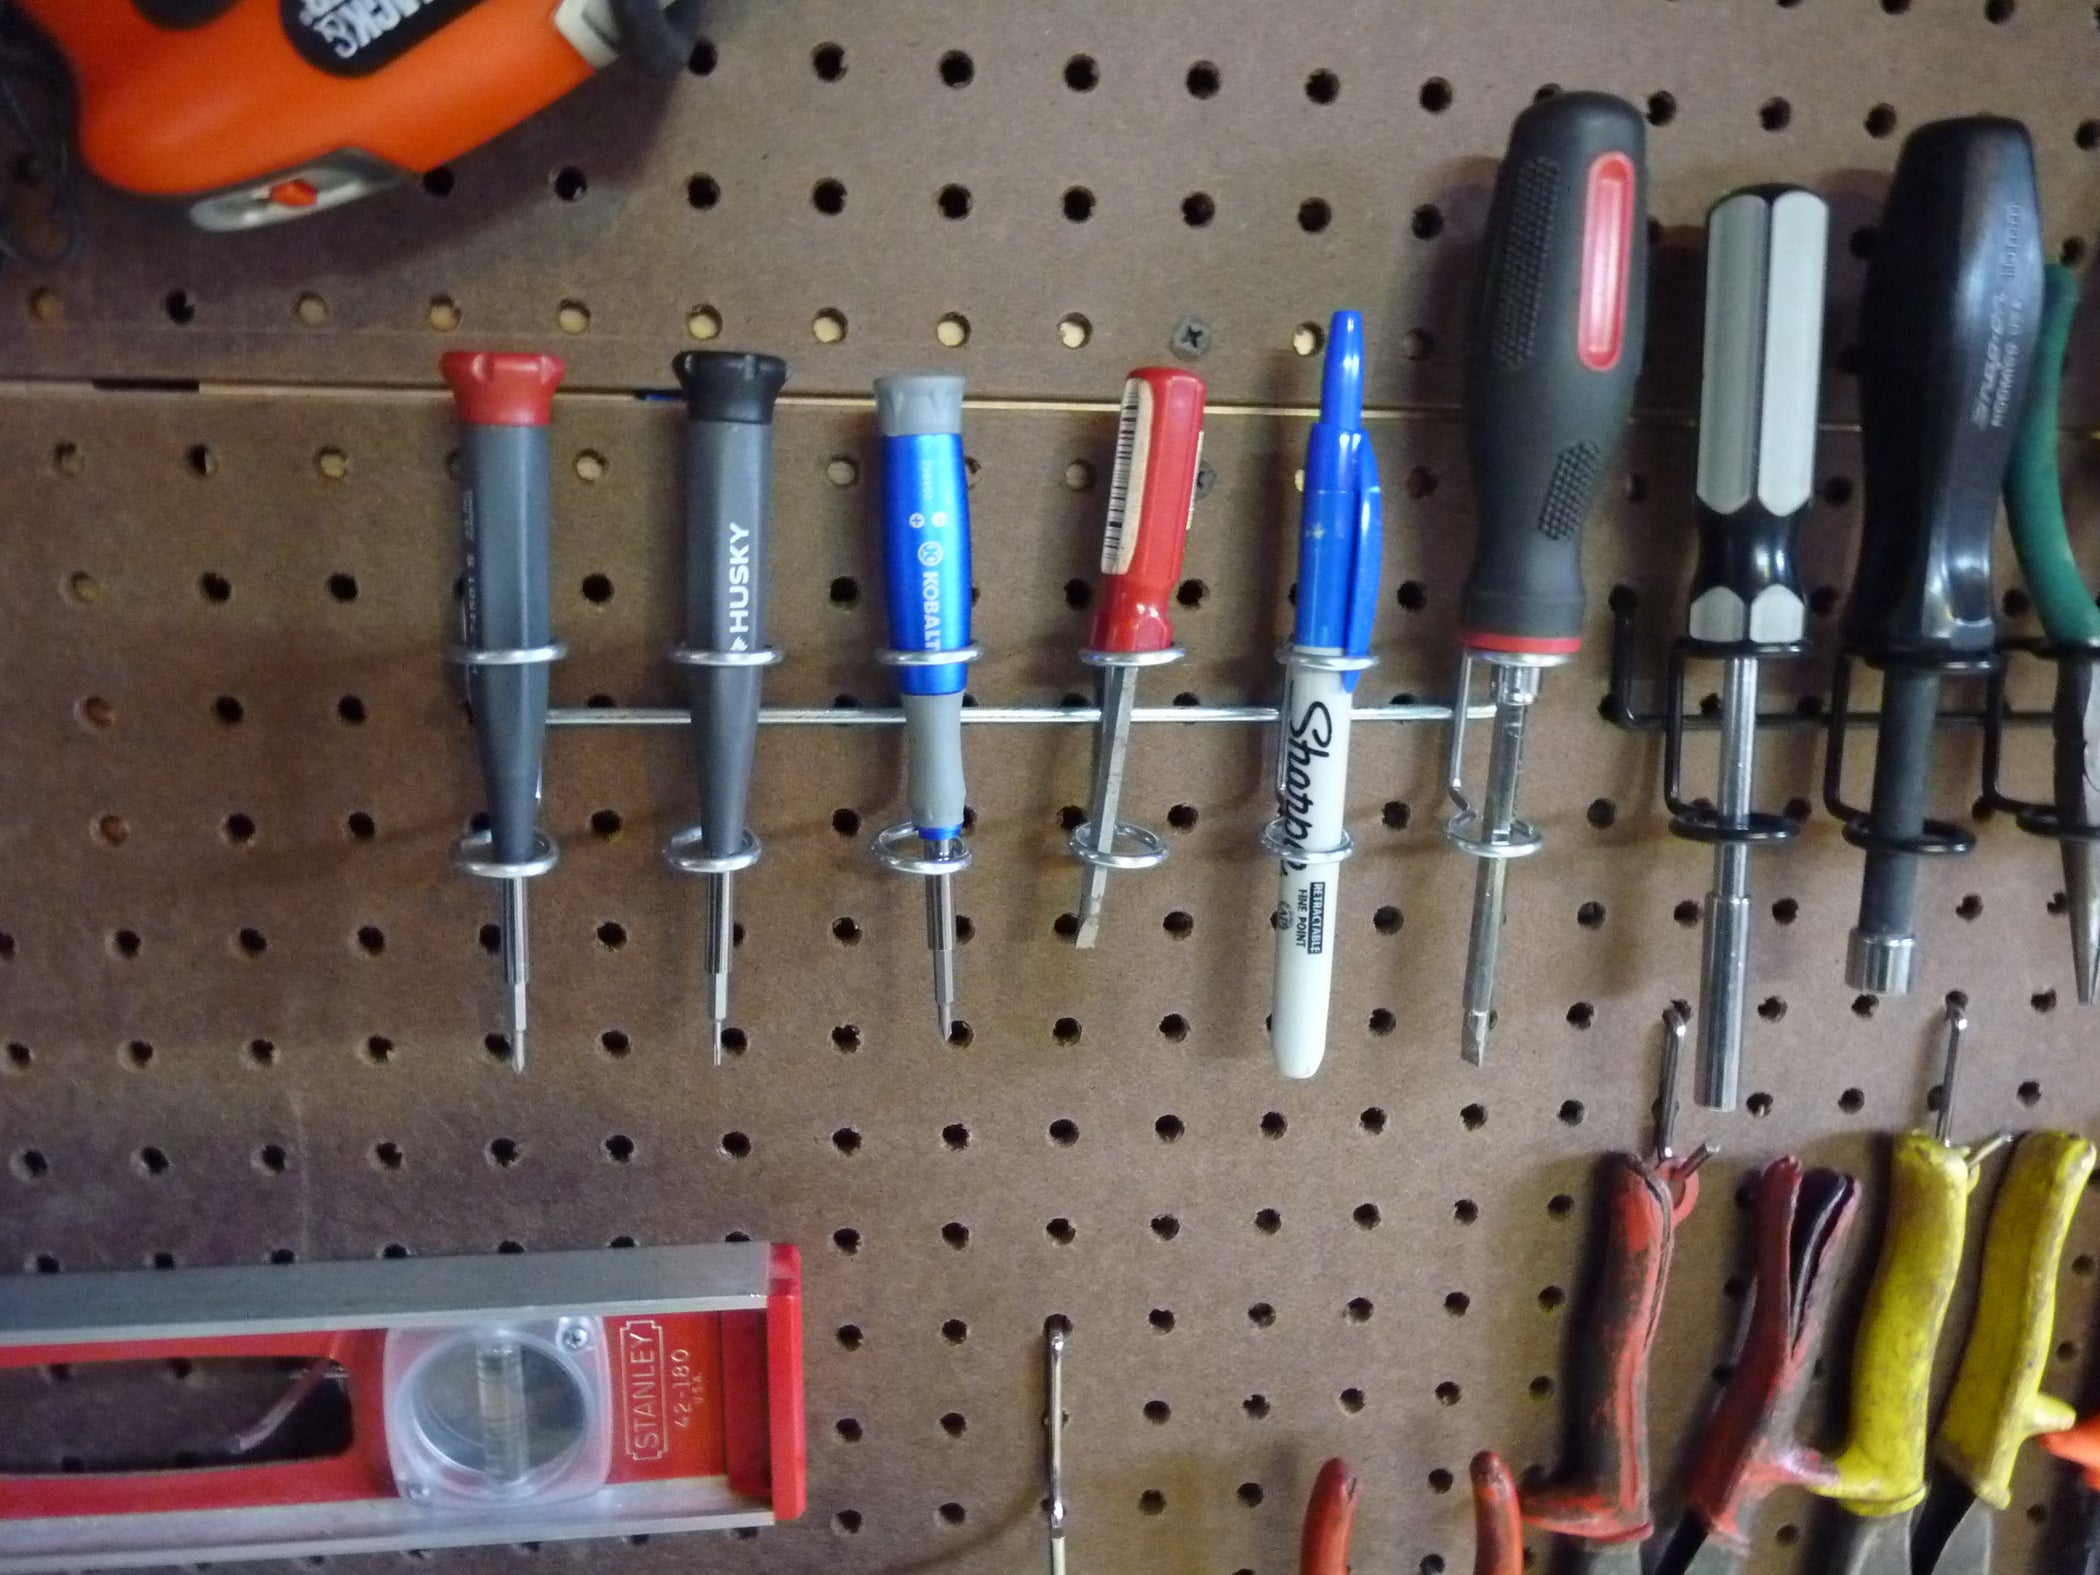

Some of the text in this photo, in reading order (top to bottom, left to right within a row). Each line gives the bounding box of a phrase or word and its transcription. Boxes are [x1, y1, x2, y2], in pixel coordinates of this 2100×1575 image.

[729, 521, 750, 633] HUSKY
[922, 570, 942, 652] KOBALT
[1296, 914, 1308, 949] POINT
[1309, 882, 1325, 954] RETRACTABLE
[630, 1332, 659, 1449] STANLEY
[670, 1348, 691, 1428] 42-180
